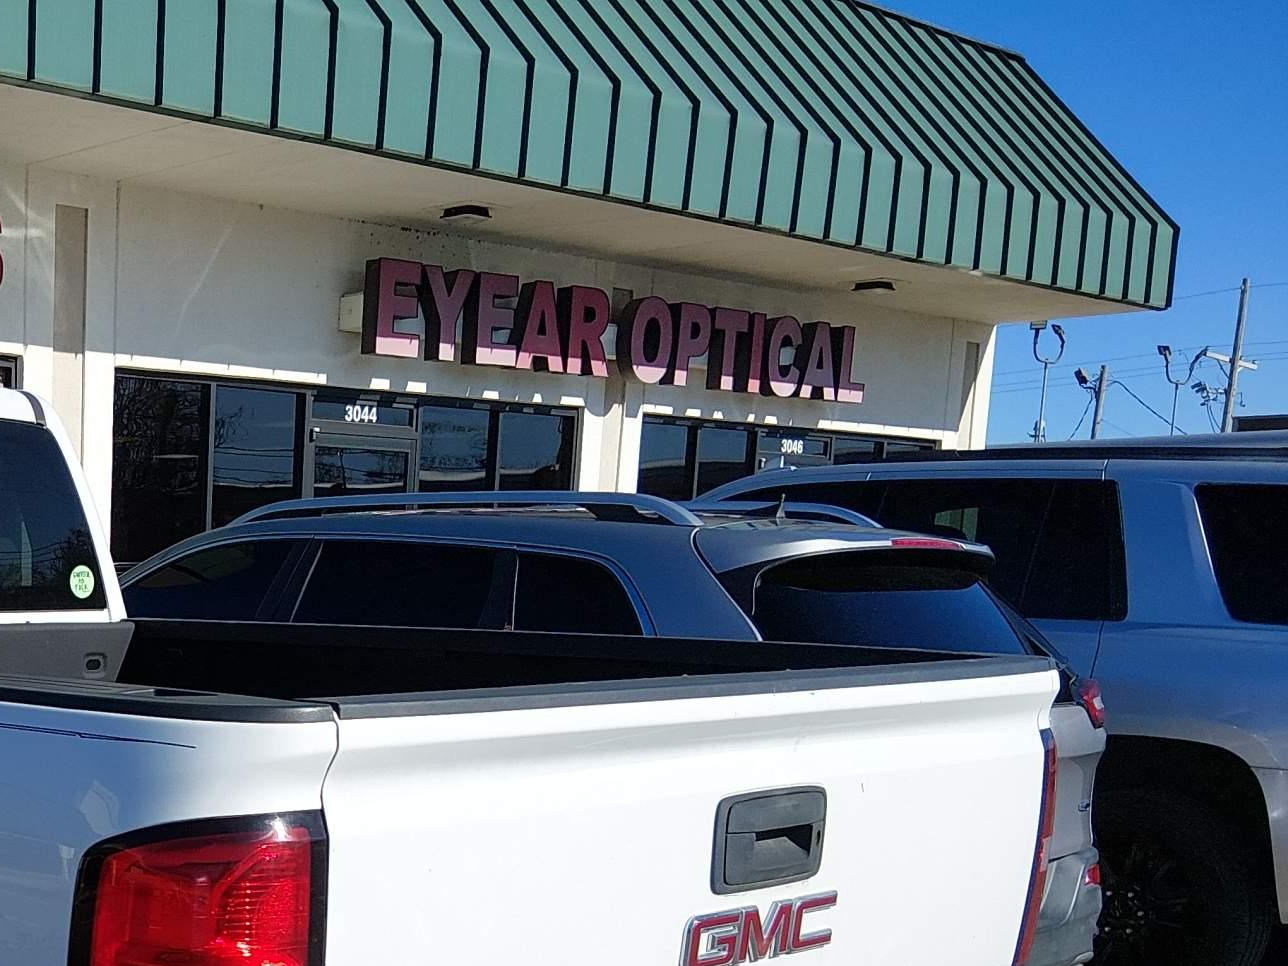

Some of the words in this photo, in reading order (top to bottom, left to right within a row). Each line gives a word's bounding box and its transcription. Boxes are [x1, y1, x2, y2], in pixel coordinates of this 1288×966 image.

[362, 257, 610, 378] EYEAR
[618, 296, 865, 403] OPTICAL
[344, 404, 378, 423] 3044
[781, 439, 804, 455] 3046
